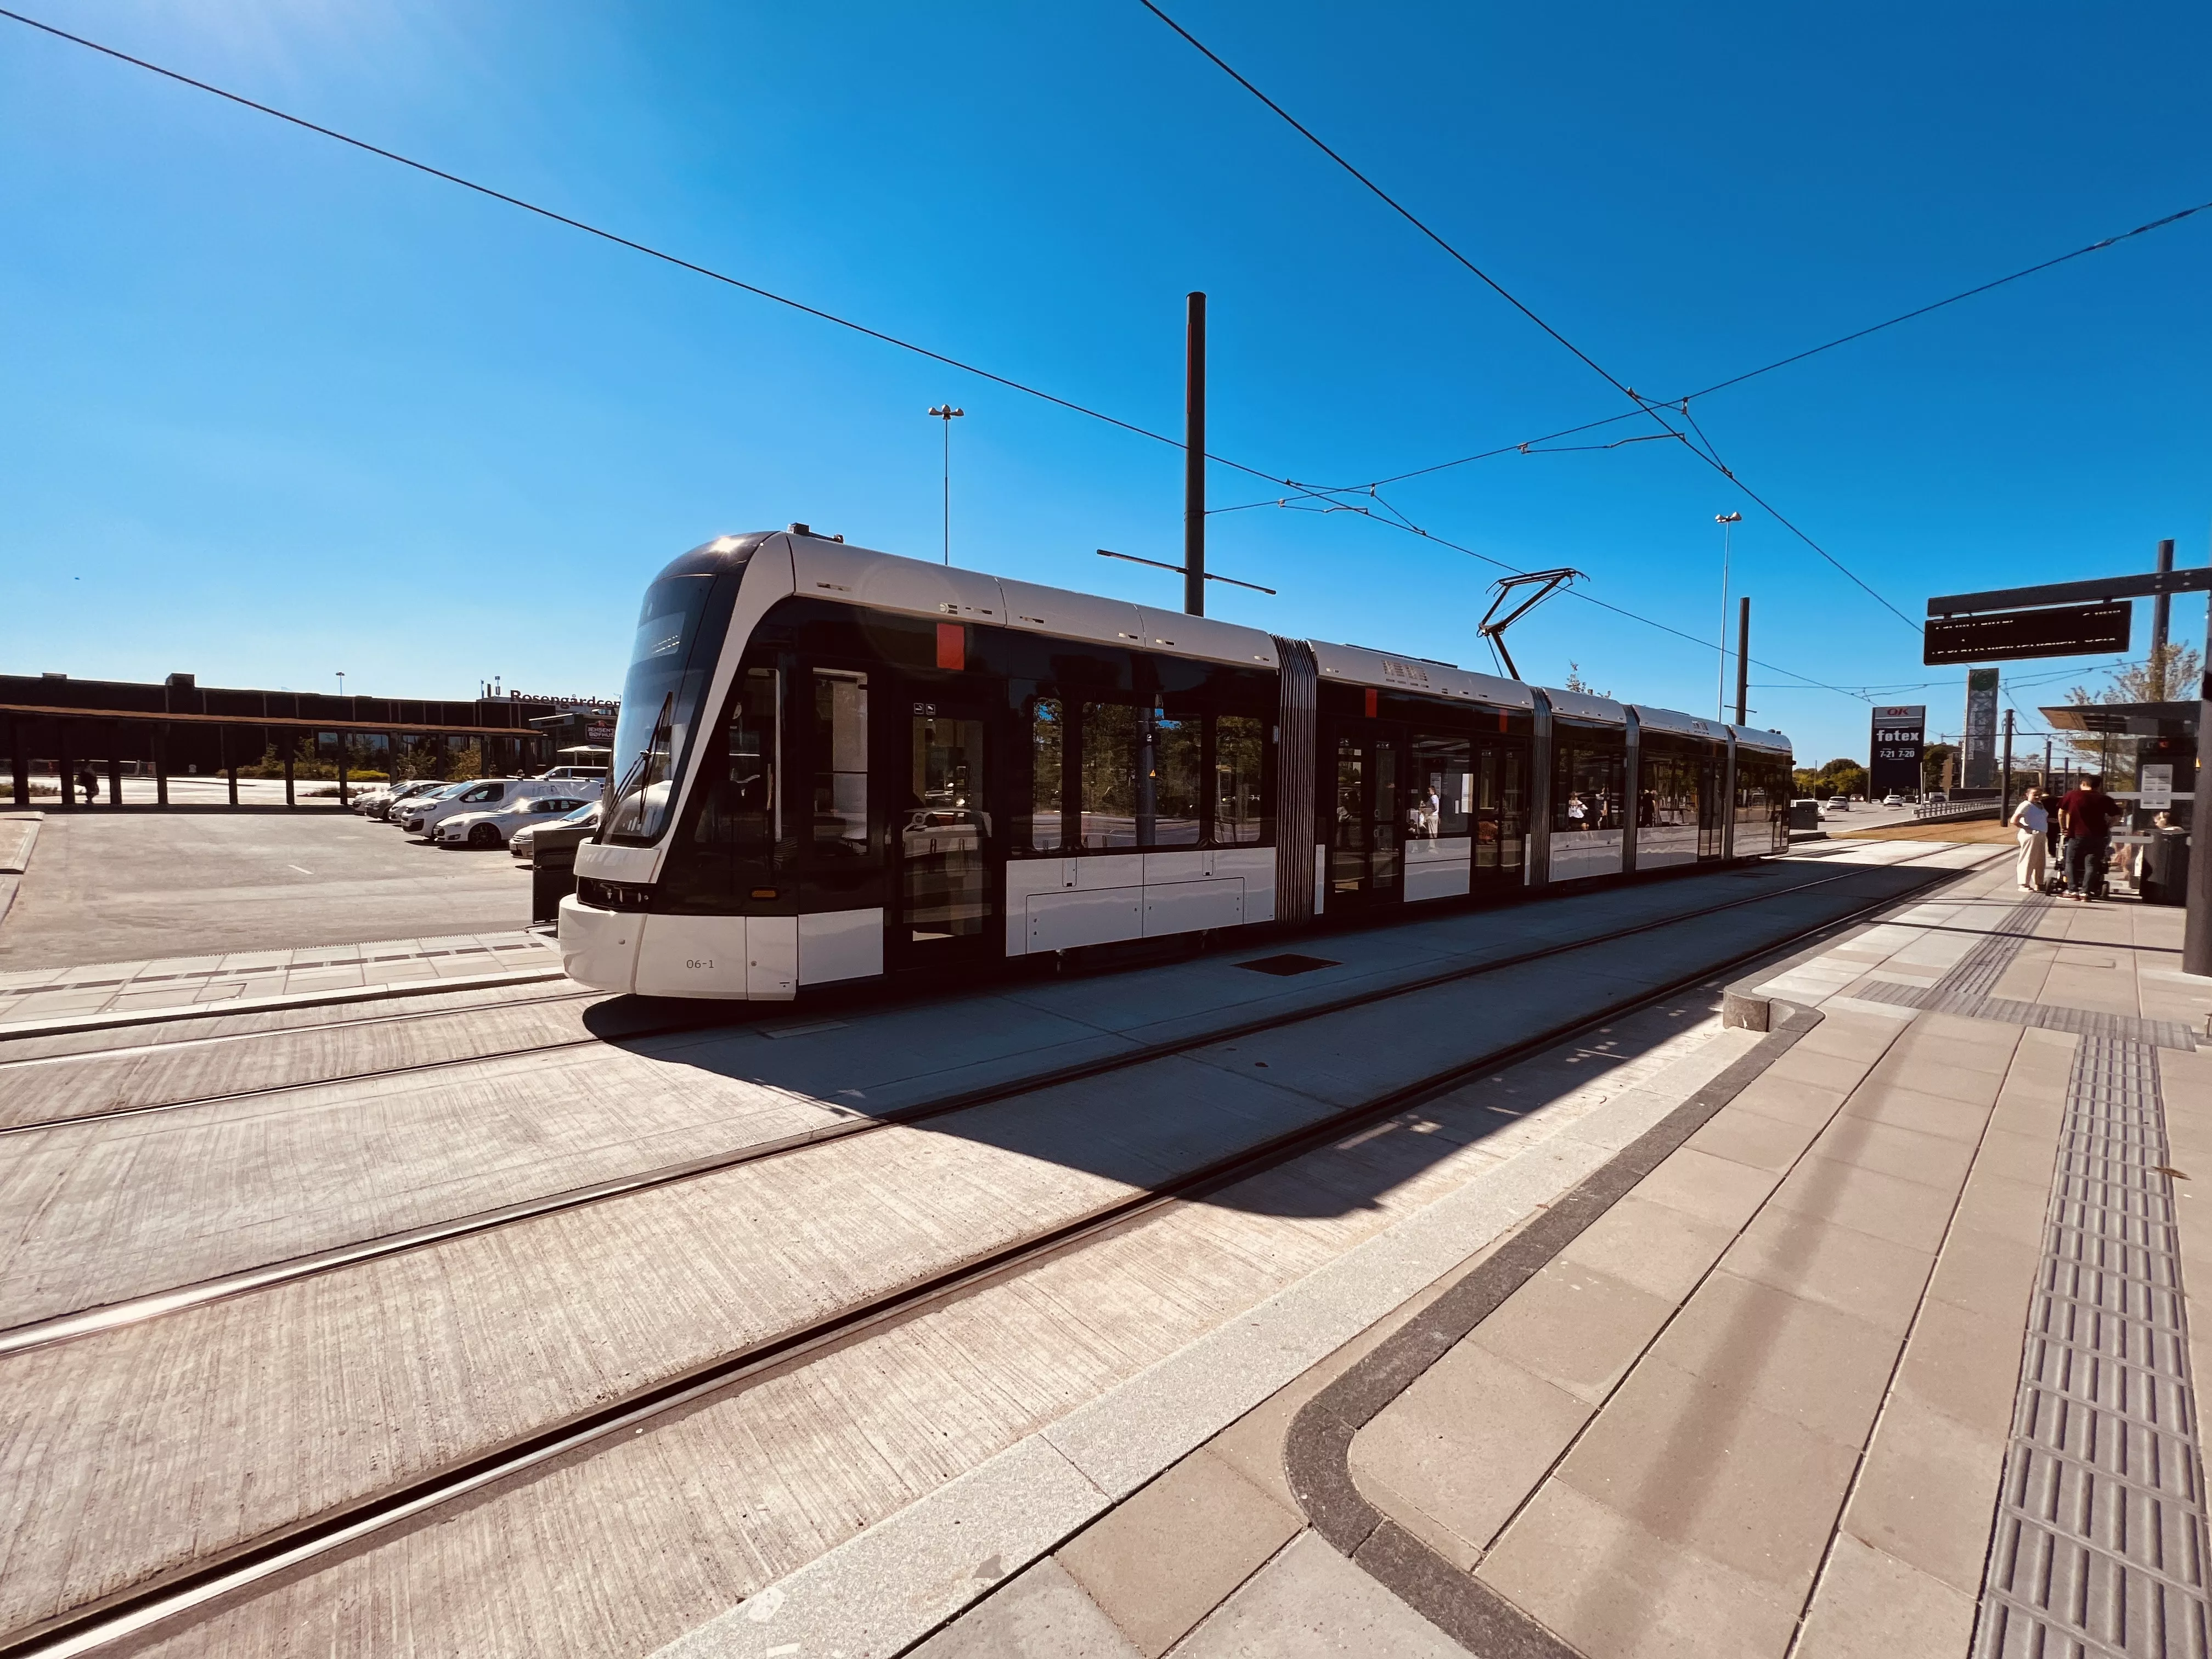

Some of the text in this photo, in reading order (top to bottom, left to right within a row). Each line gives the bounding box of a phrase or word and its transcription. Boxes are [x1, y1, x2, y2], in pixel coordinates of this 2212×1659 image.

[1887, 708, 1909, 716] OK
[1967, 708, 1978, 760] Rosegårdcentret
[686, 960, 714, 968] 06-1
